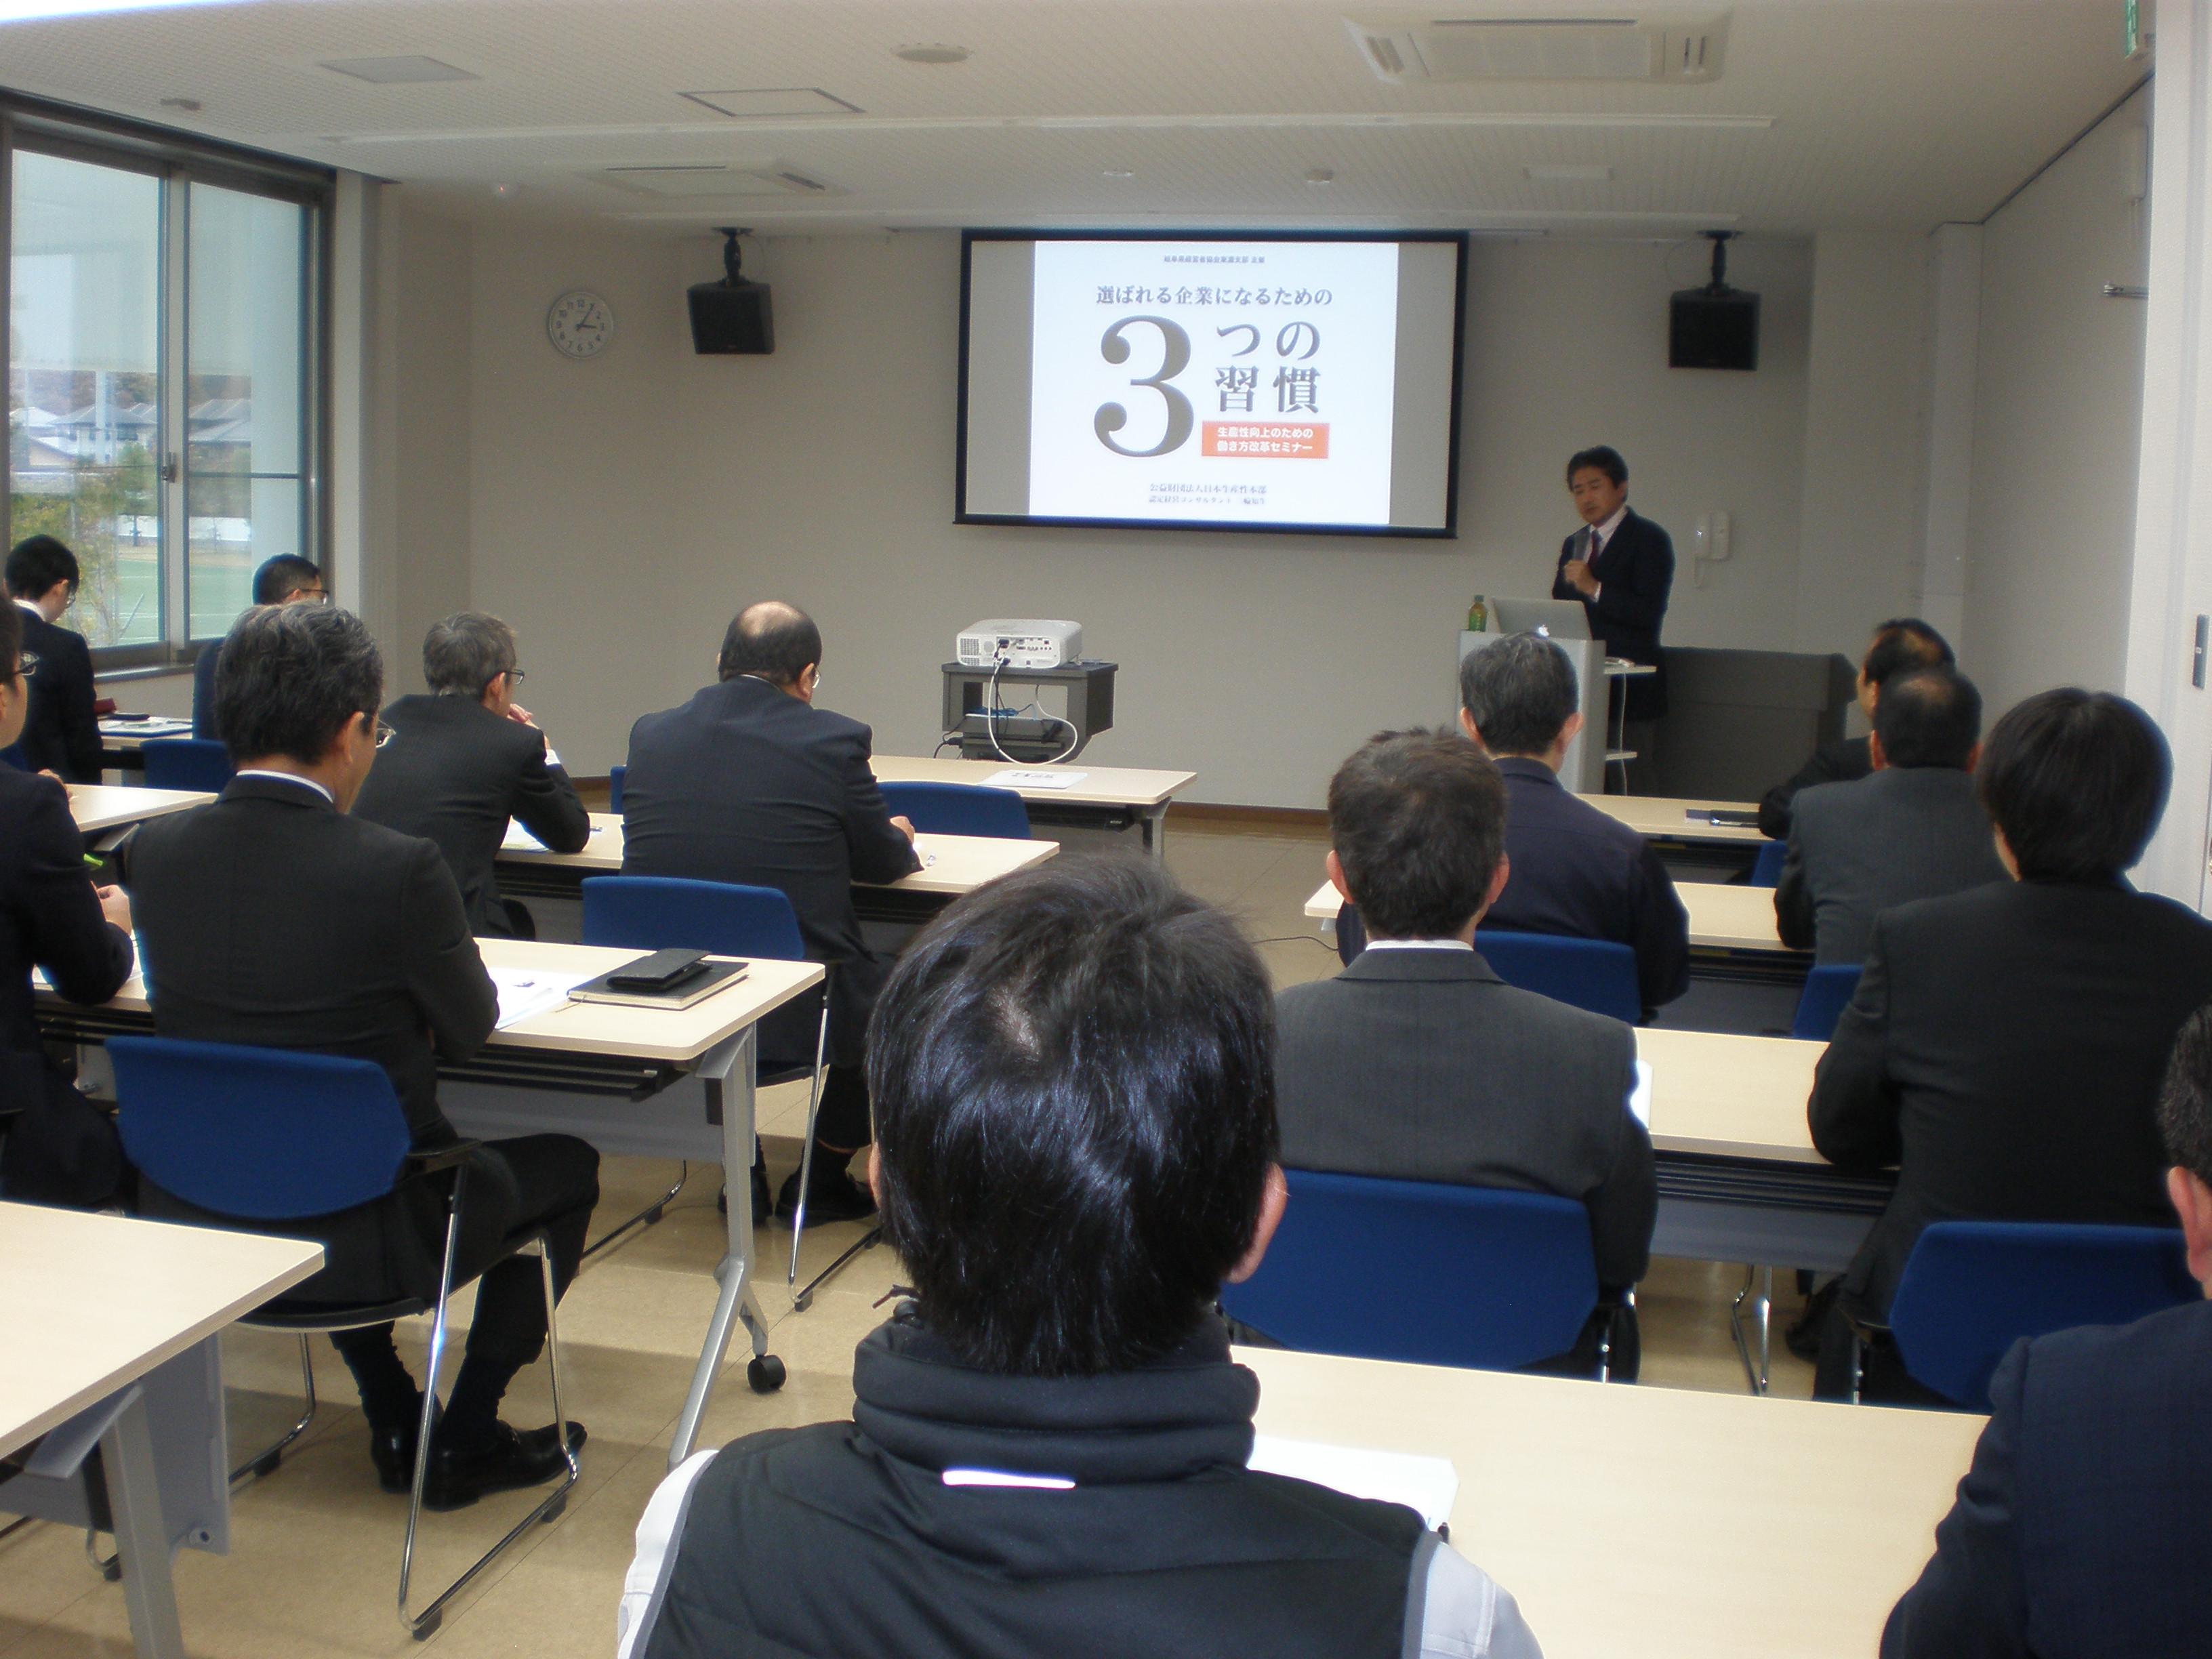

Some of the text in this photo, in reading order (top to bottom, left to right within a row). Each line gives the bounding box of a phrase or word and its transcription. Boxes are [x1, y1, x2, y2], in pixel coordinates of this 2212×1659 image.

[1096, 285, 1333, 306] 選ばれる企業になるための
[1094, 316, 1193, 457] 3
[1215, 366, 1319, 414] 習慣
[1217, 426, 1314, 439] 生産性向上のための
[1216, 441, 1313, 453] 働き方改革セミナー
